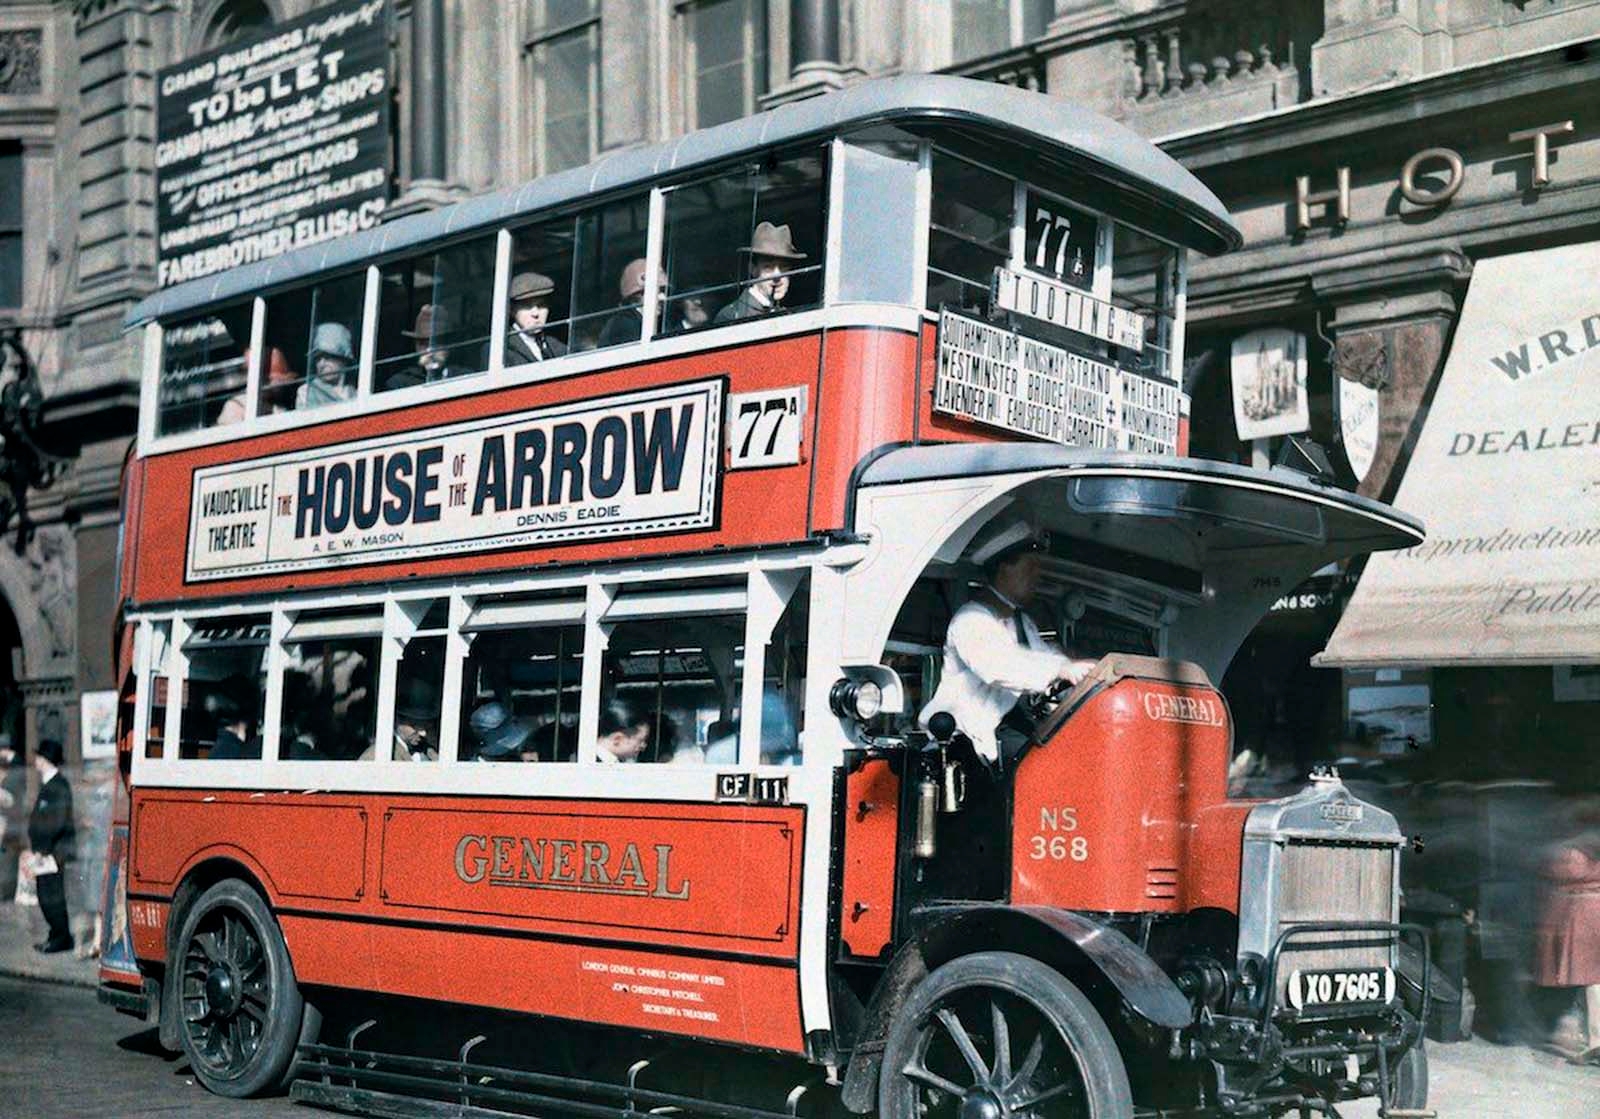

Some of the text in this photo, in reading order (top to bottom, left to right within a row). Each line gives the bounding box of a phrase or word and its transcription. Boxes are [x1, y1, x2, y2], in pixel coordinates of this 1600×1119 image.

[188, 91, 229, 126] TO
[233, 87, 265, 112] be
[270, 51, 344, 99] LET
[319, 68, 385, 111] SHOPS
[1014, 275, 1116, 340] TOOTING
[942, 315, 1004, 361] SOUTHAMPTON
[1068, 356, 1110, 395] STRAND
[1121, 372, 1176, 417] WHITEHALL
[942, 346, 1018, 394] WESTMINSTER
[1028, 374, 1064, 410] BRIDGE
[938, 379, 985, 419] LAVENDER
[738, 396, 798, 459] 77A
[452, 454, 467, 477] OF
[471, 403, 694, 515] ARROW
[202, 484, 269, 518] VAUDEVILLE
[277, 445, 444, 539] THE HOUSE
[449, 482, 468, 508] THE
[516, 504, 621, 527] DENNIS EADIE
[208, 522, 257, 552] THEATRE
[361, 532, 405, 547] MASON
[1144, 692, 1223, 726] GENERAL
[722, 775, 745, 796] CF
[1041, 807, 1077, 831] NS
[1030, 836, 1088, 862] 368
[454, 834, 691, 901] GENERAL
[582, 961, 608, 972] LONDON
[609, 964, 636, 976] GENERAL
[637, 967, 666, 979] OMNIBUS
[668, 970, 699, 983] COMPANY
[1306, 972, 1380, 1004] XO 7605
